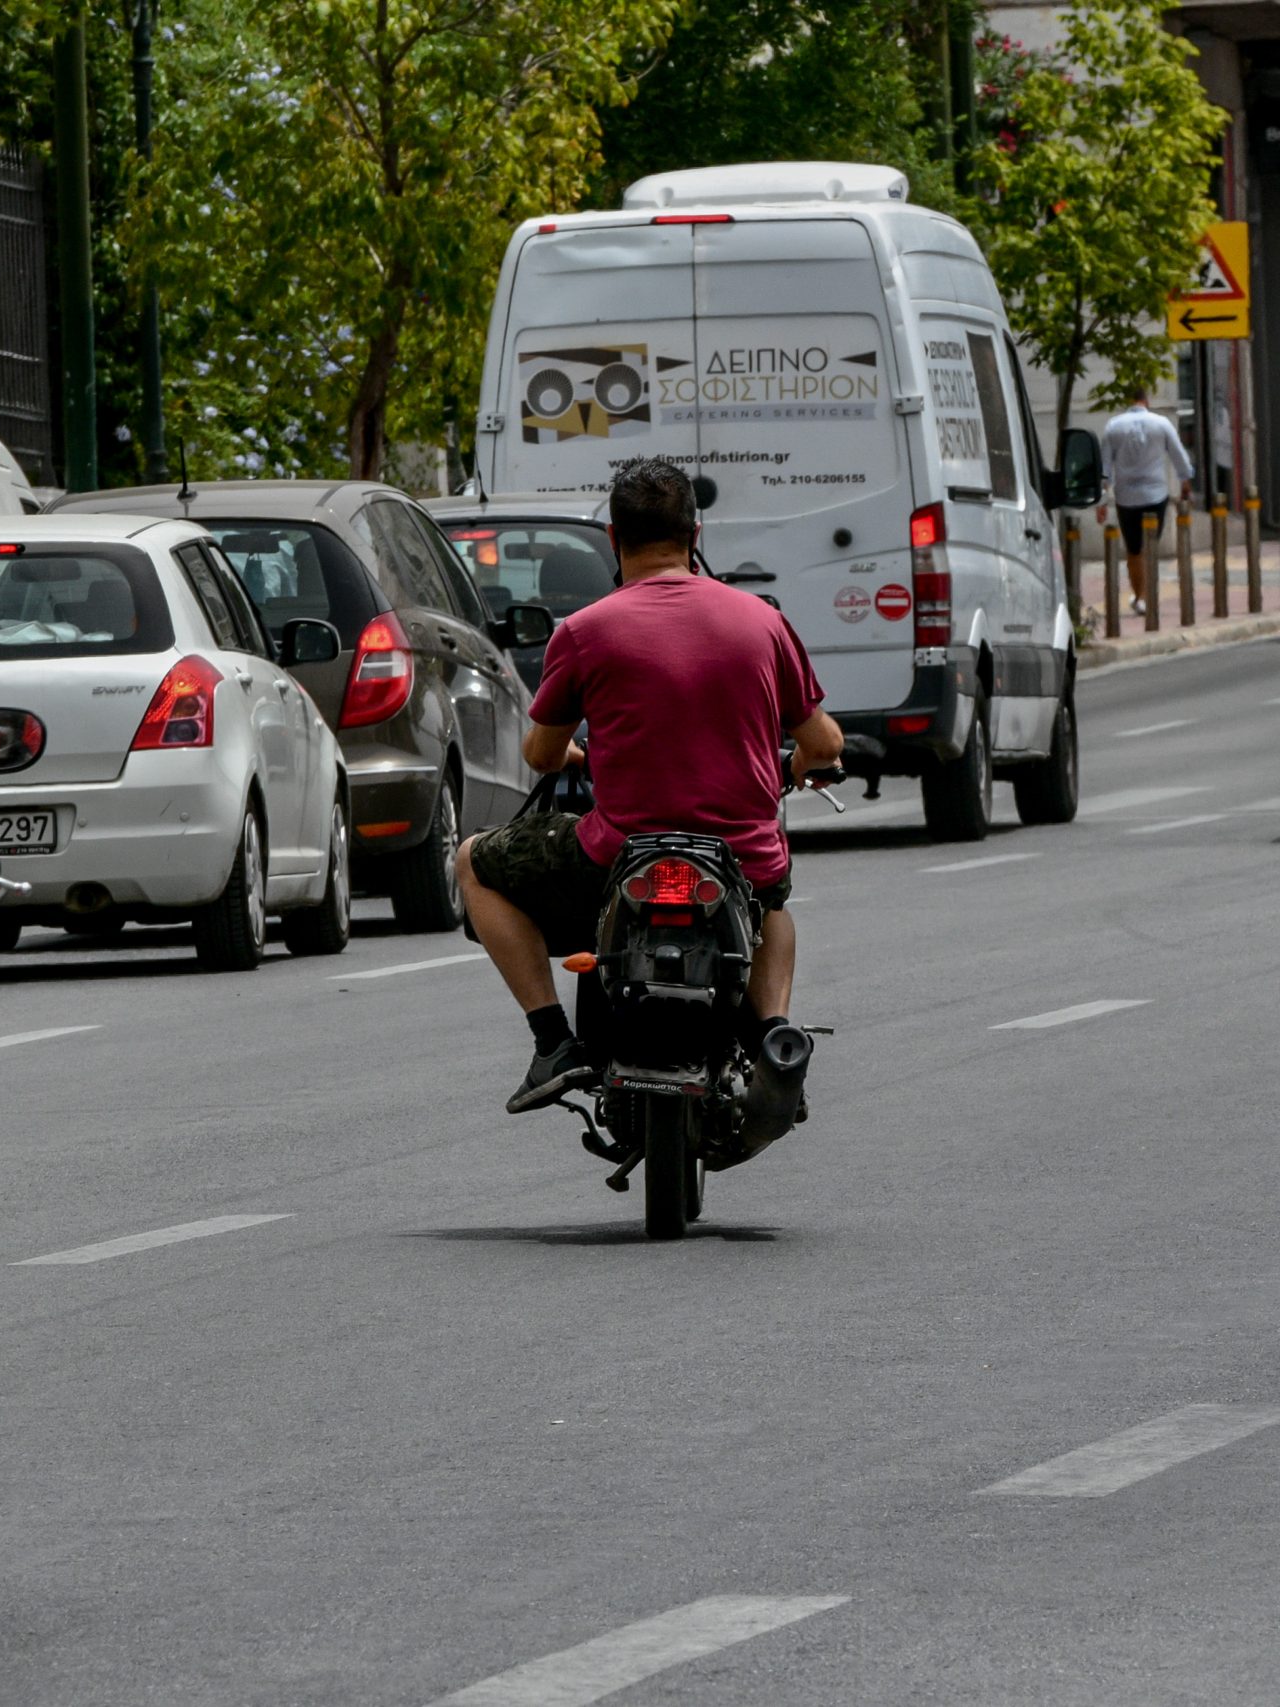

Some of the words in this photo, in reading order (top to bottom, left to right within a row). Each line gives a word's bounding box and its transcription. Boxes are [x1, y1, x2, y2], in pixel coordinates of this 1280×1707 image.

[706, 347, 828, 374] ΔΕΙΠΝΟ
[658, 374, 878, 404] ΣΟΦΙΣΤΗΡΙΟΝ
[674, 409, 762, 421] CATERING
[773, 408, 863, 418] SERVICES
[762, 475, 787, 486] Τηλ.
[790, 474, 866, 485] 210-6206155
